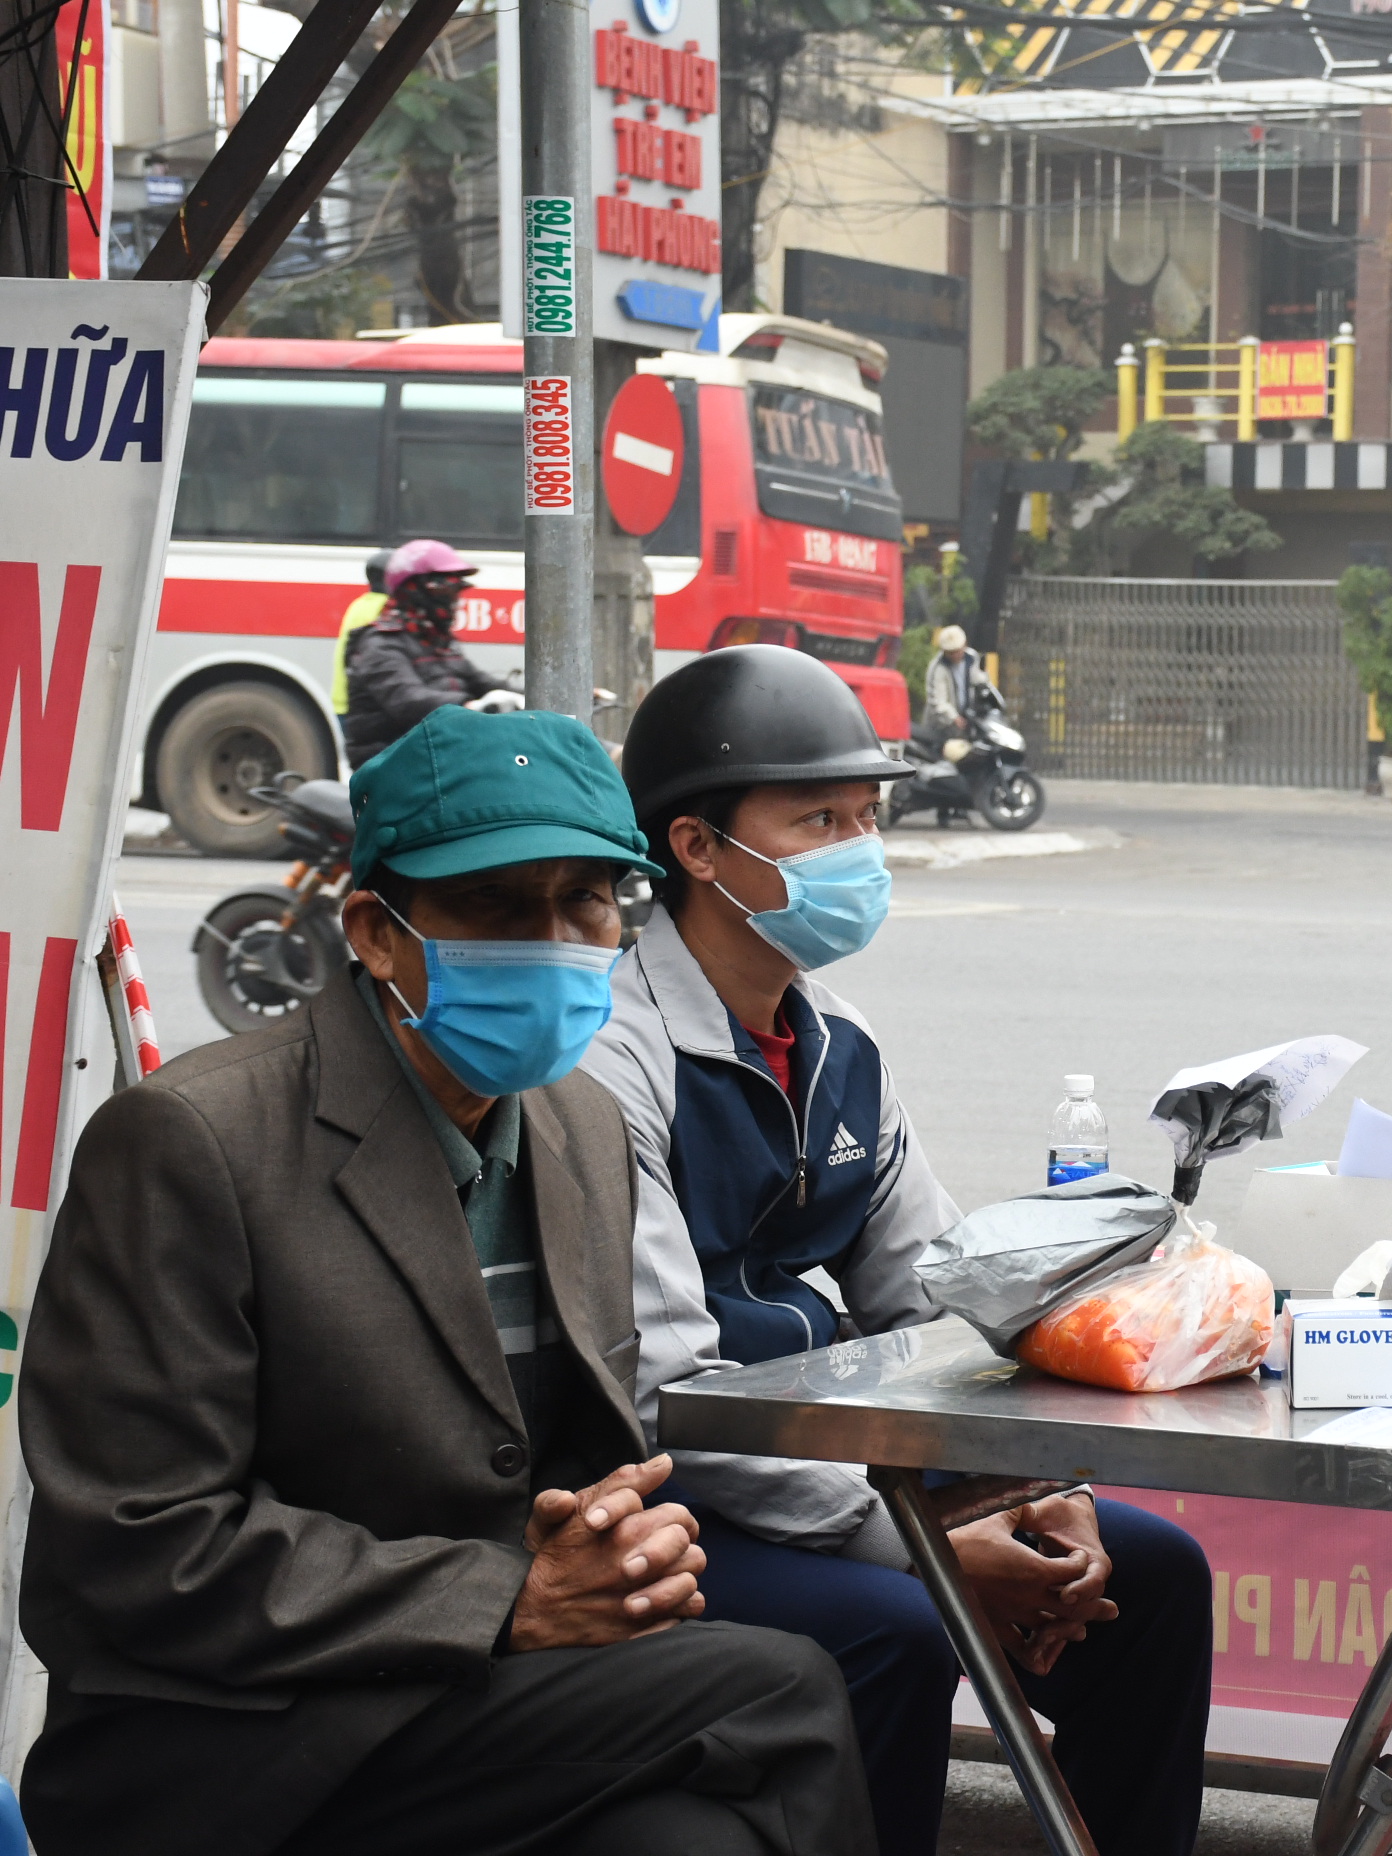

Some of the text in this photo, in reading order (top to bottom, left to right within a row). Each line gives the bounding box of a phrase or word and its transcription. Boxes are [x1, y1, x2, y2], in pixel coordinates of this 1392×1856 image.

[533, 199, 573, 333] 0981.244.768
[531, 378, 572, 508] 0981.808.345
[827, 1147, 867, 1166] adidas
[1304, 1330, 1331, 1344] HM
